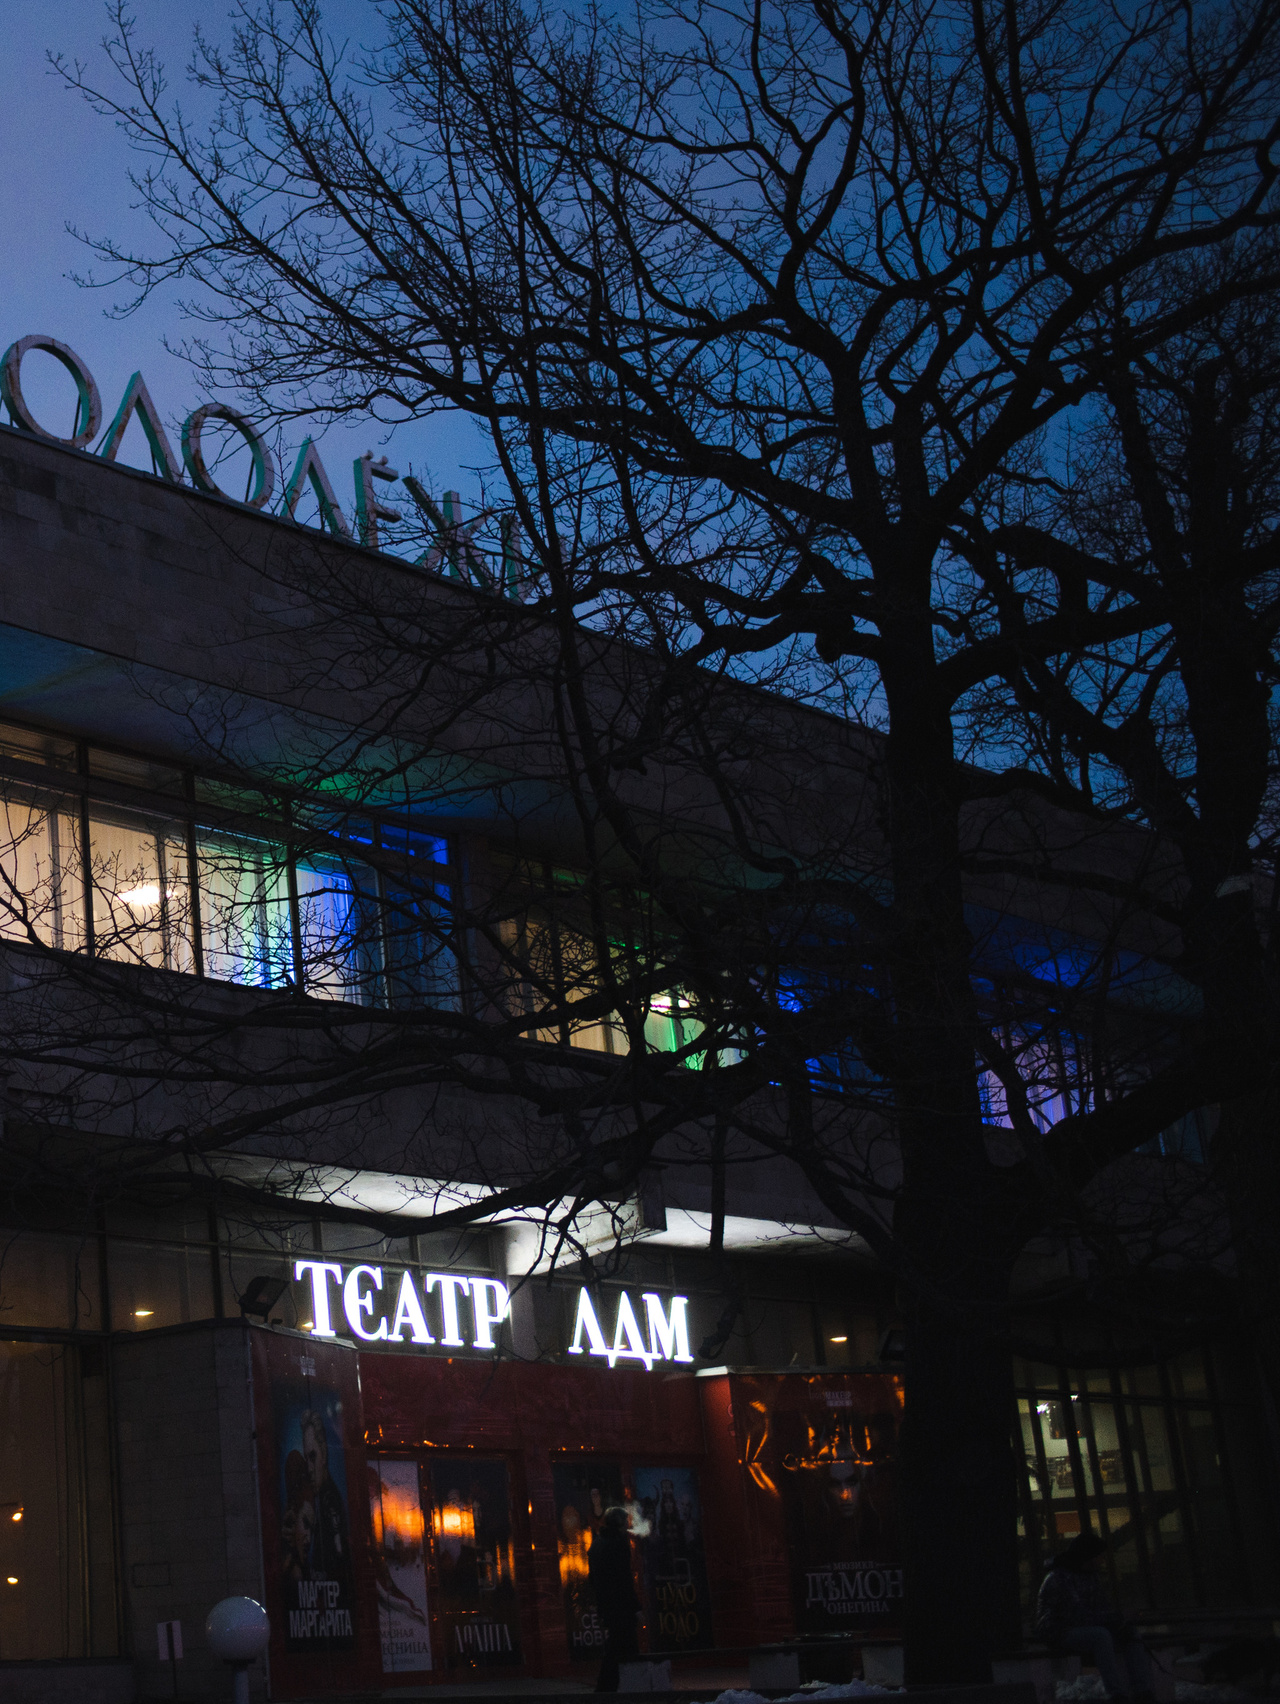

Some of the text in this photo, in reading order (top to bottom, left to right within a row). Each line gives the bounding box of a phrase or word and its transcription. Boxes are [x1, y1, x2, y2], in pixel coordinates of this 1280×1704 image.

[295, 1260, 695, 1371] ТЕАТР ЛДМ
[288, 1608, 354, 1639] МАРГАРИТА
[827, 1601, 890, 1616] ОНЕГИНА
